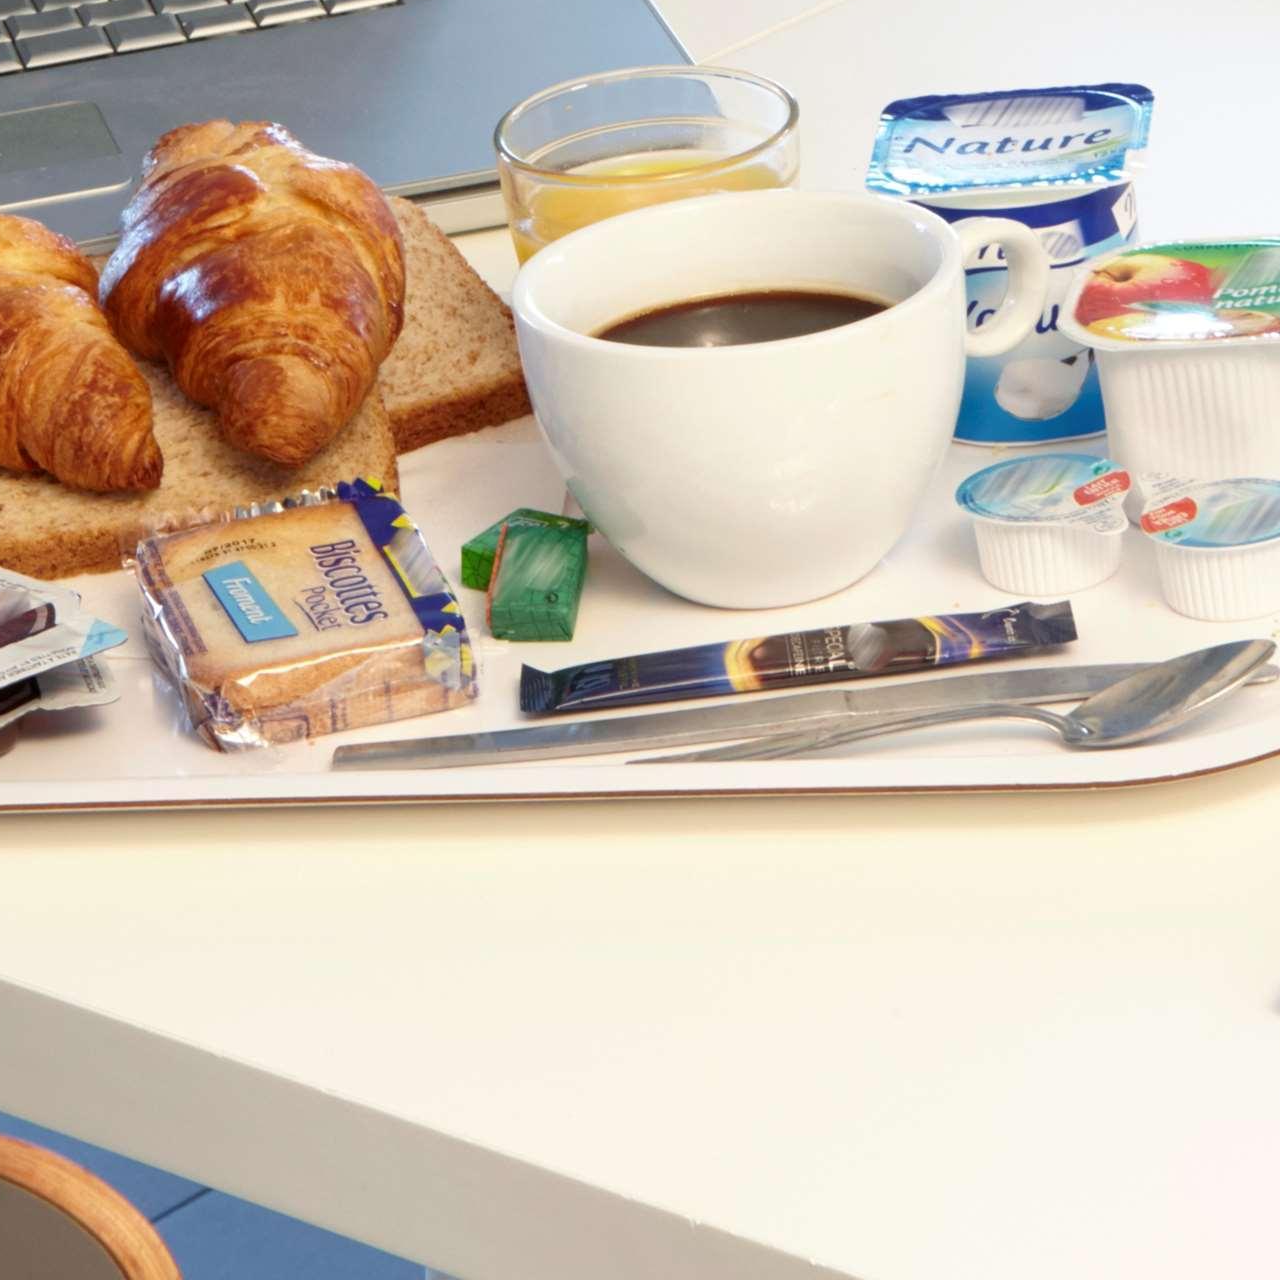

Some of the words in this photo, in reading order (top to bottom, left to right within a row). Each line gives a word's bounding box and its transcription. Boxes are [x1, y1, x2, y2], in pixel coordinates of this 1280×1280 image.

[903, 127, 1111, 155] Nature
[222, 577, 273, 625] Froment
[310, 540, 389, 624] Biscottes
[300, 586, 341, 631] Pocket
